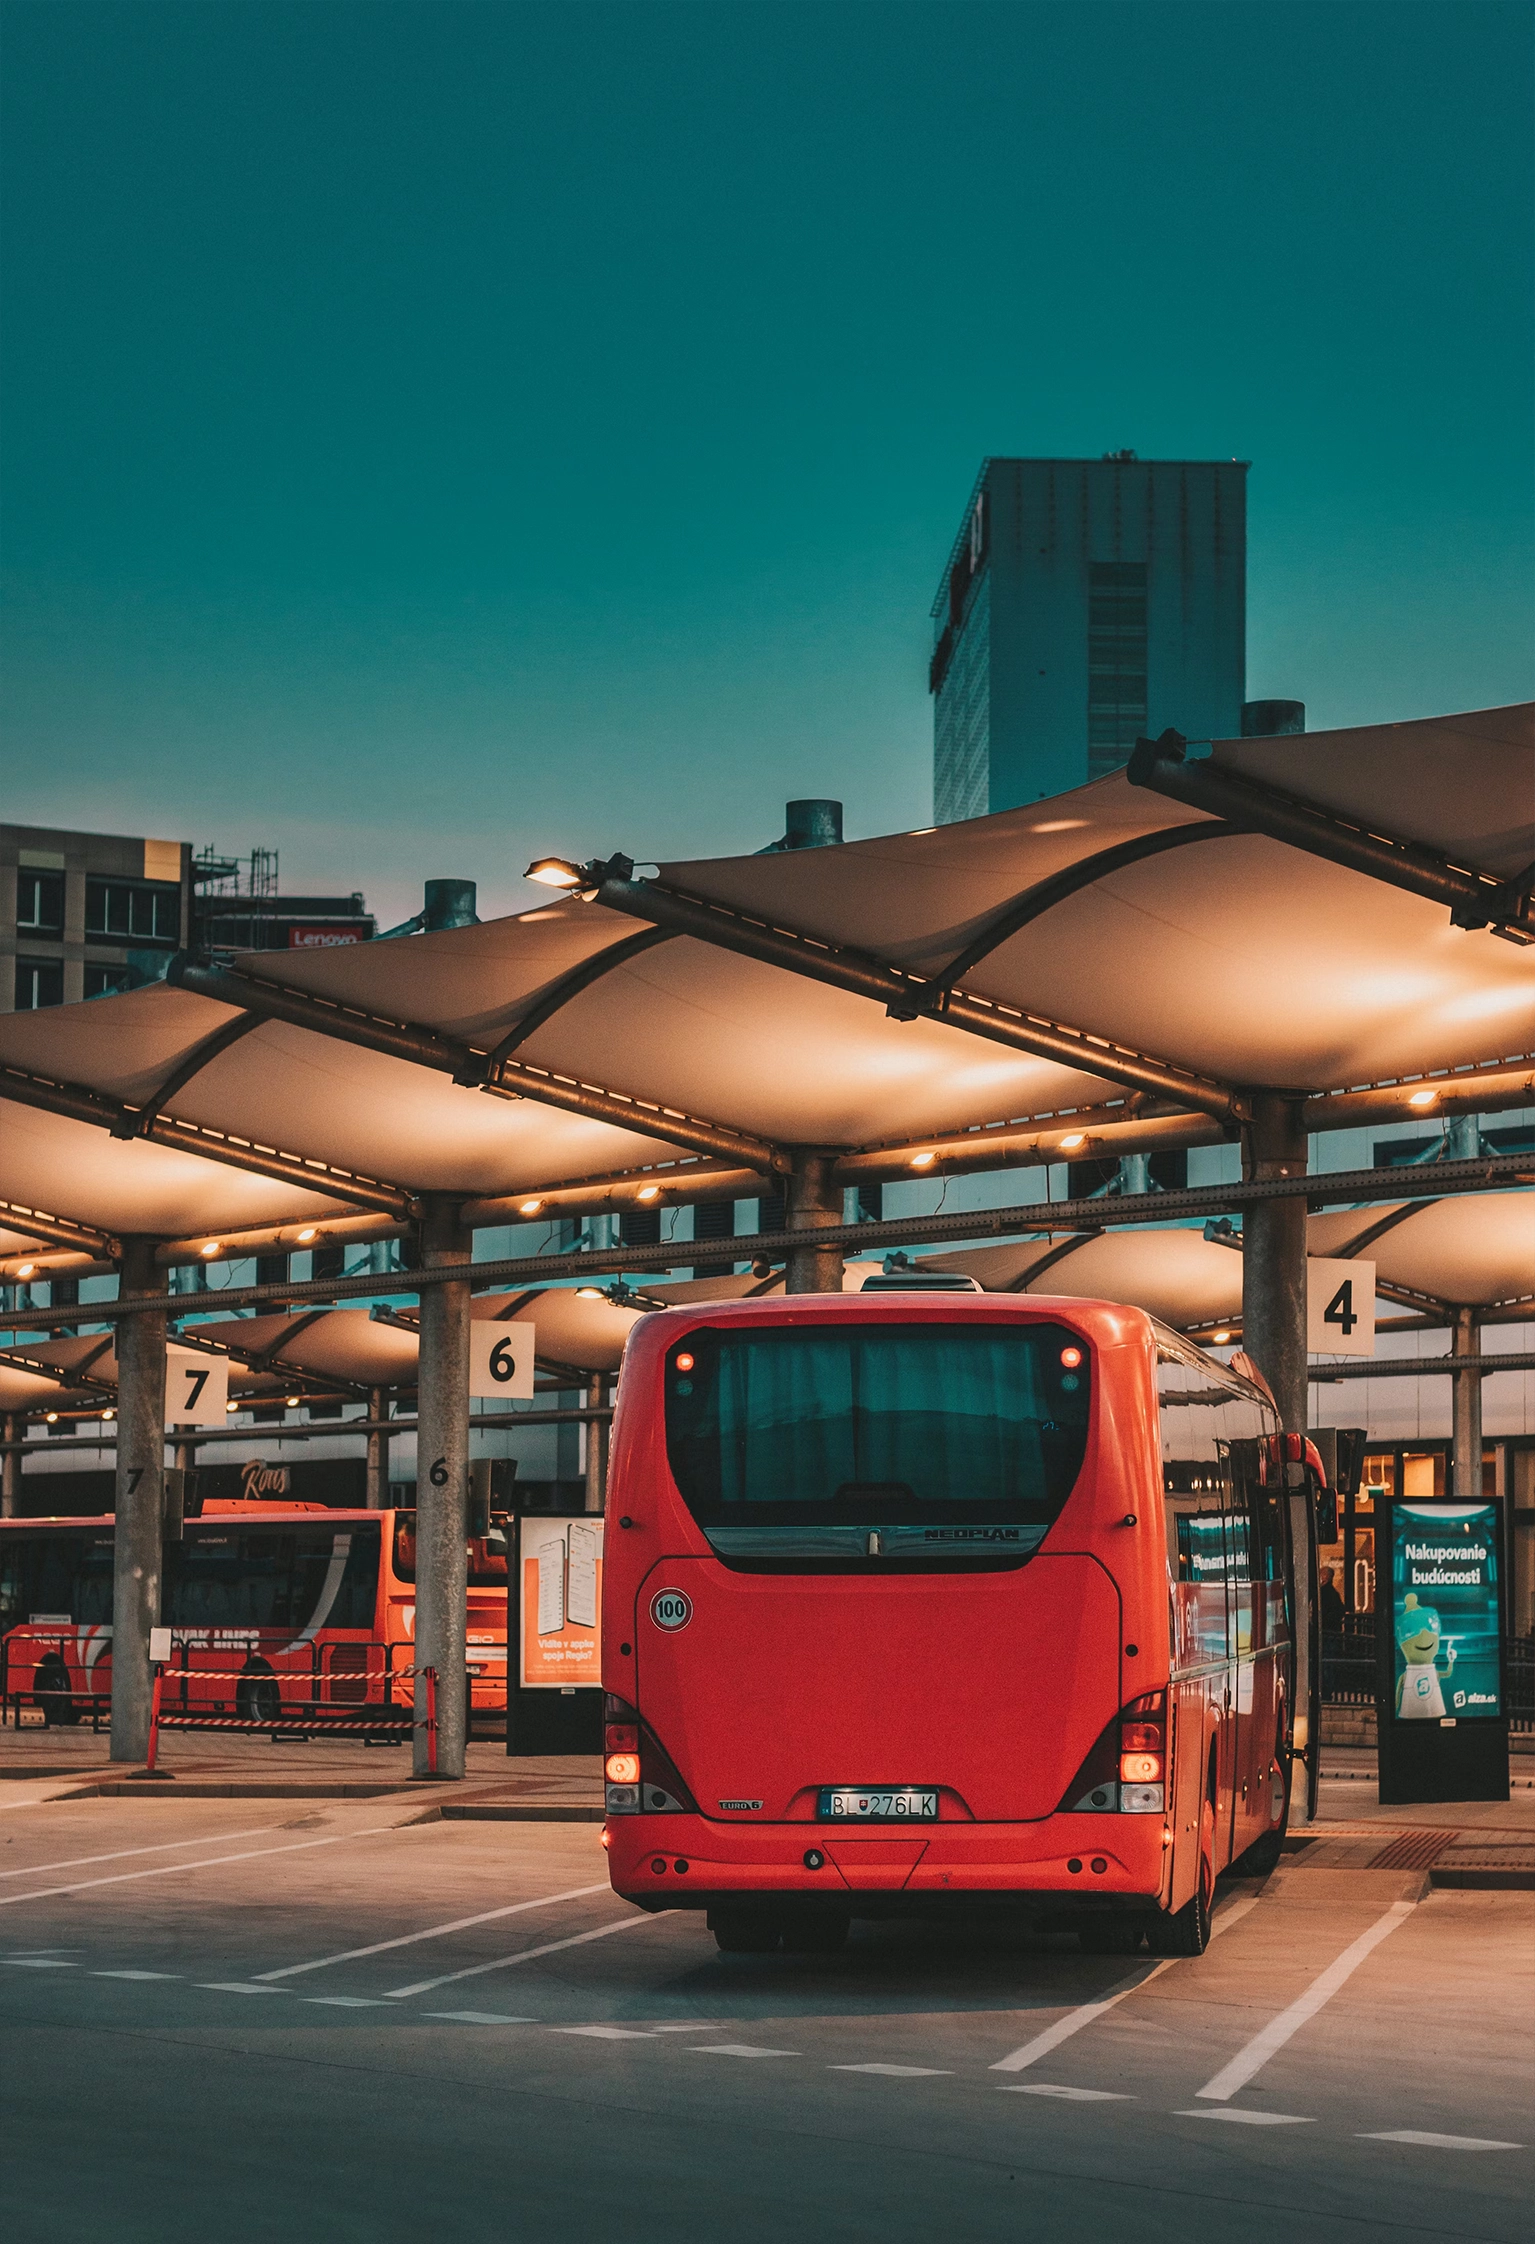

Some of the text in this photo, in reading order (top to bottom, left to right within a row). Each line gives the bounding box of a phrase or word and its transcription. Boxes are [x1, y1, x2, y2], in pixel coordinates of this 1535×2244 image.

[1324, 1280, 1357, 1335] 4
[489, 1336, 515, 1382] 6
[184, 1369, 210, 1410] 7
[127, 1468, 144, 1494] 7
[429, 1457, 448, 1487] 6
[925, 1529, 1019, 1540] NEOPLAN
[1405, 1543, 1487, 1564] Nakupovanie
[1412, 1567, 1480, 1584] budúcnosti
[658, 1600, 685, 1618] 100
[752, 1801, 760, 1809] 6
[833, 1796, 857, 1815] BL
[870, 1796, 933, 1815] 276LK
